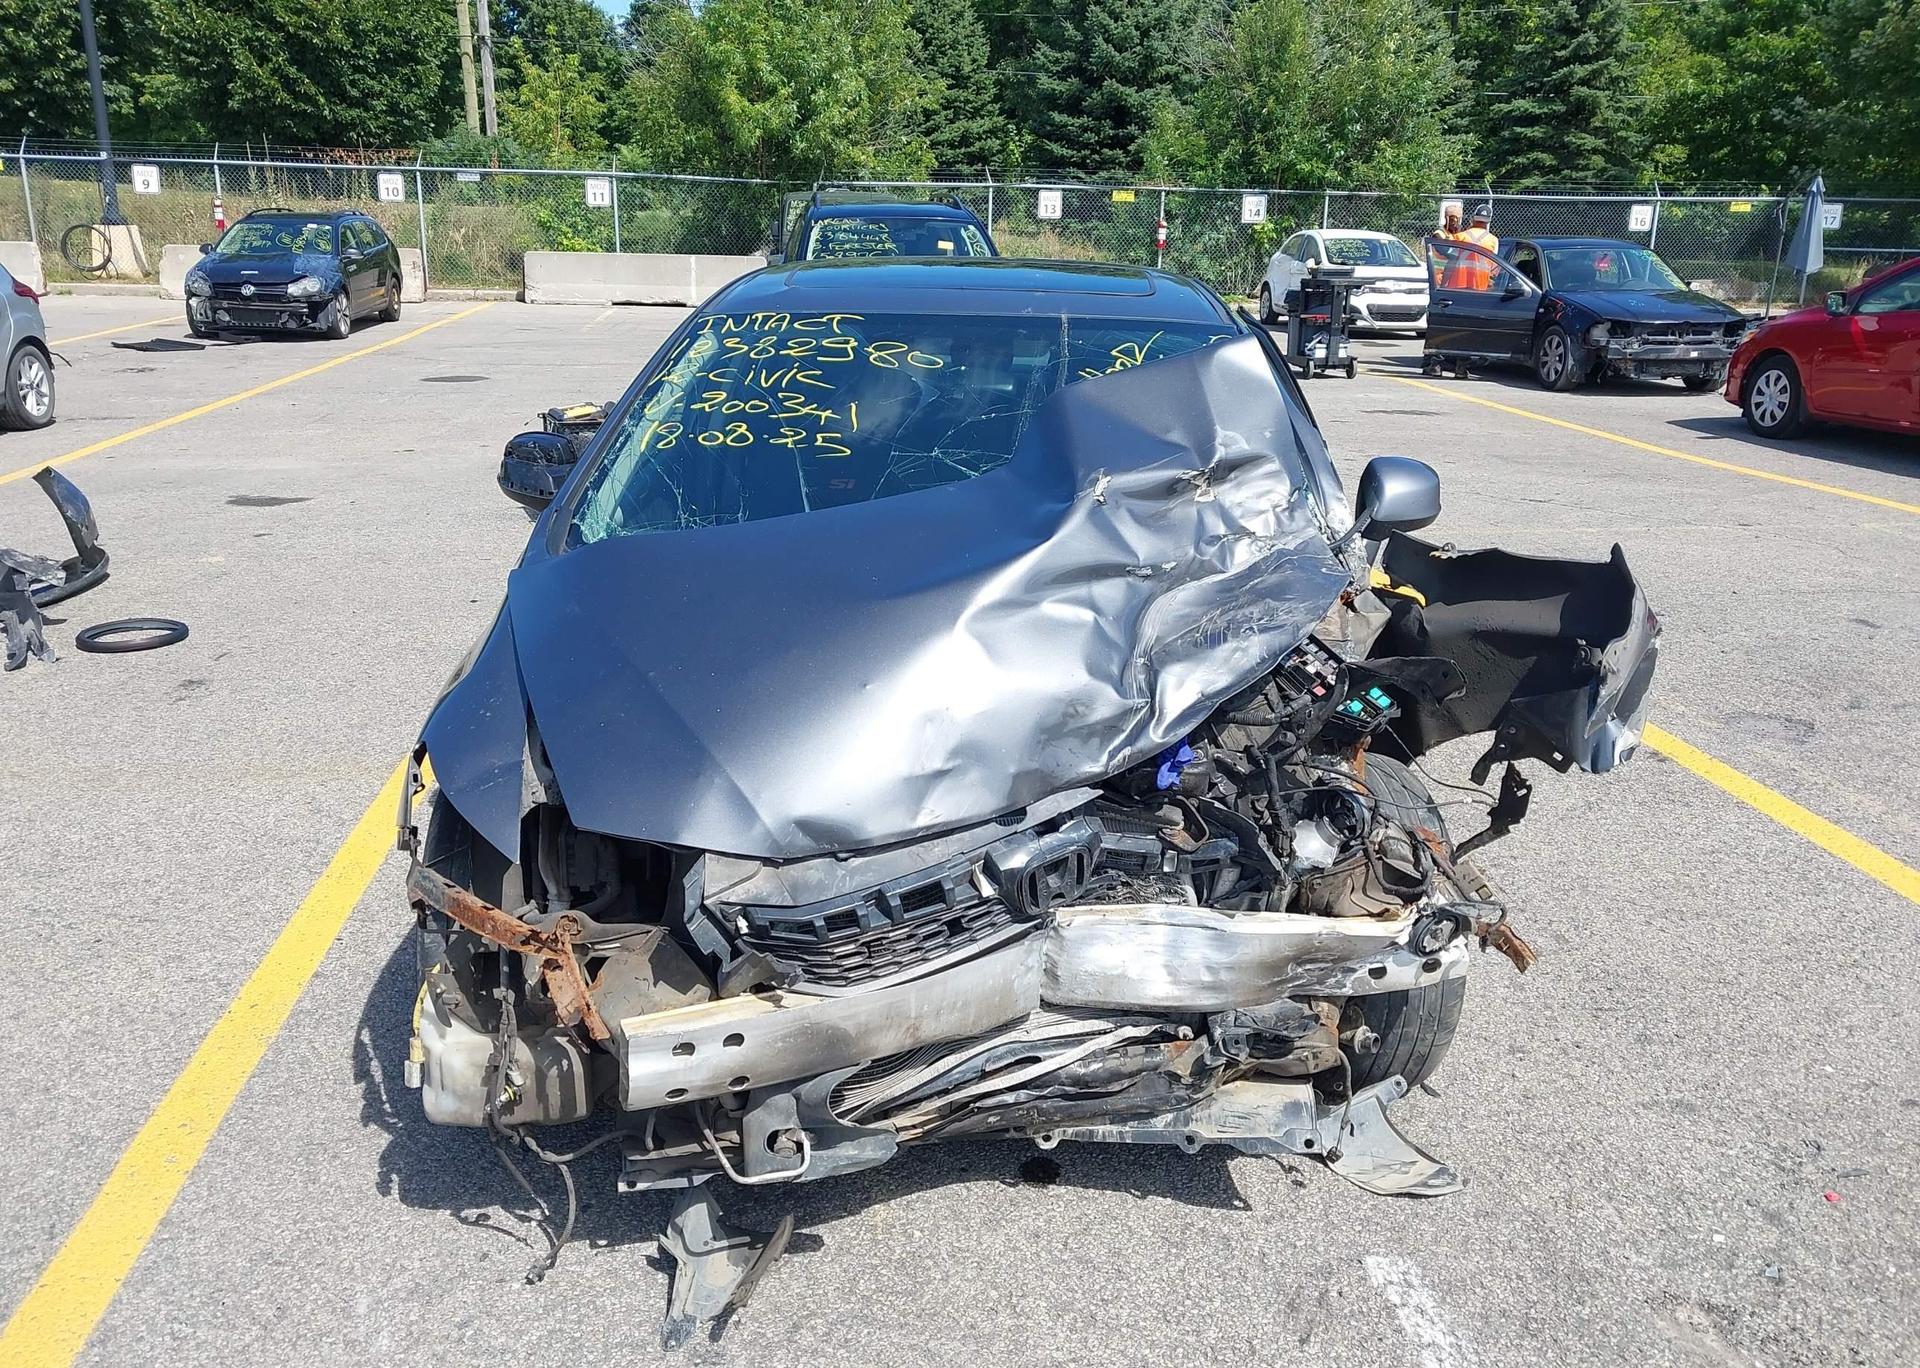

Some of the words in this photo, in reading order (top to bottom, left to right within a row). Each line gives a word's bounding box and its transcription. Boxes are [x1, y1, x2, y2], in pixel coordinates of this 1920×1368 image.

[142, 179, 150, 189] 9
[384, 187, 399, 197] 10
[592, 192, 604, 202] 11
[1044, 204, 1056, 214] 13
[1248, 208, 1261, 218] 14
[1634, 217, 1646, 226] 16
[1823, 216, 1837, 226] 17
[697, 311, 865, 334] INTACT
